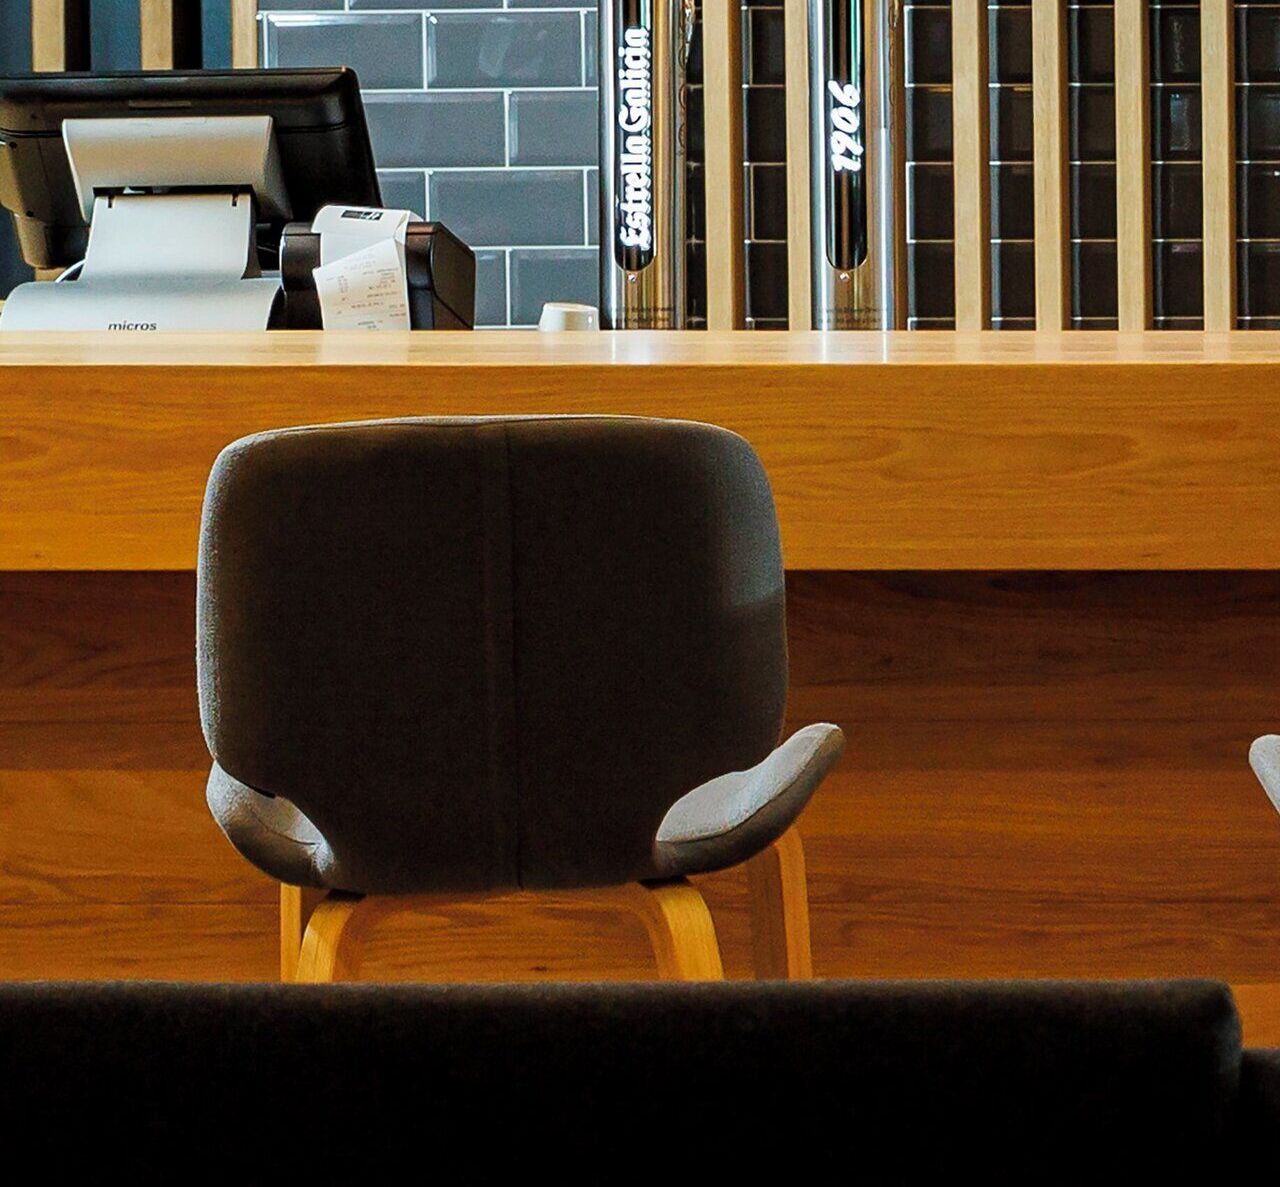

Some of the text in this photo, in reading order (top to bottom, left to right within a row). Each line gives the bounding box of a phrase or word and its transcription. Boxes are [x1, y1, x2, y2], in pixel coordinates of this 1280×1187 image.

[617, 27, 650, 251] Estrella Galicia
[828, 80, 864, 172] 1906
[108, 320, 157, 331] micros
